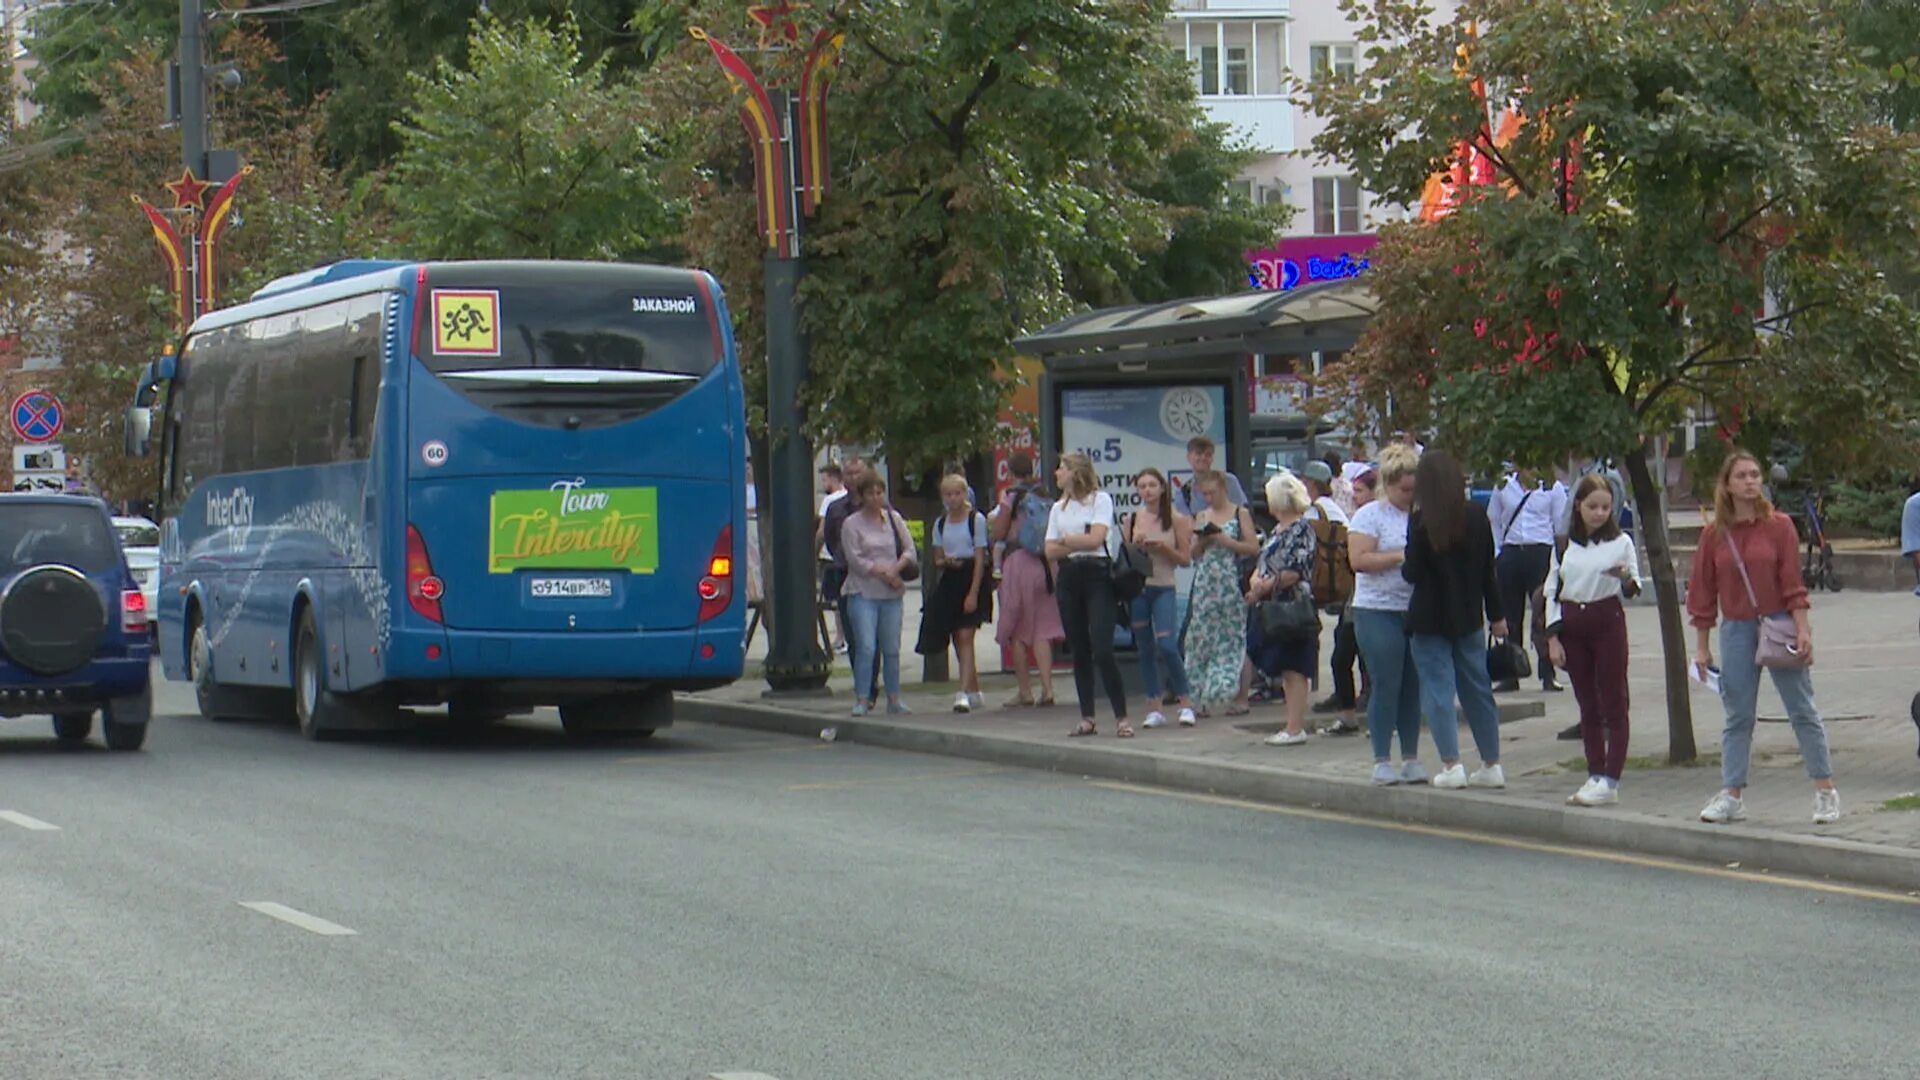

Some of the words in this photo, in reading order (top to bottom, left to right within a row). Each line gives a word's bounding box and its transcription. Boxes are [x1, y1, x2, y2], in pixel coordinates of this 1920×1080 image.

[632, 296, 696, 313] ЗАКАЗНОЙ
[427, 448, 444, 459] 60
[206, 486, 255, 530] InterCity
[550, 476, 609, 517] Tour
[496, 508, 650, 564] Intercity
